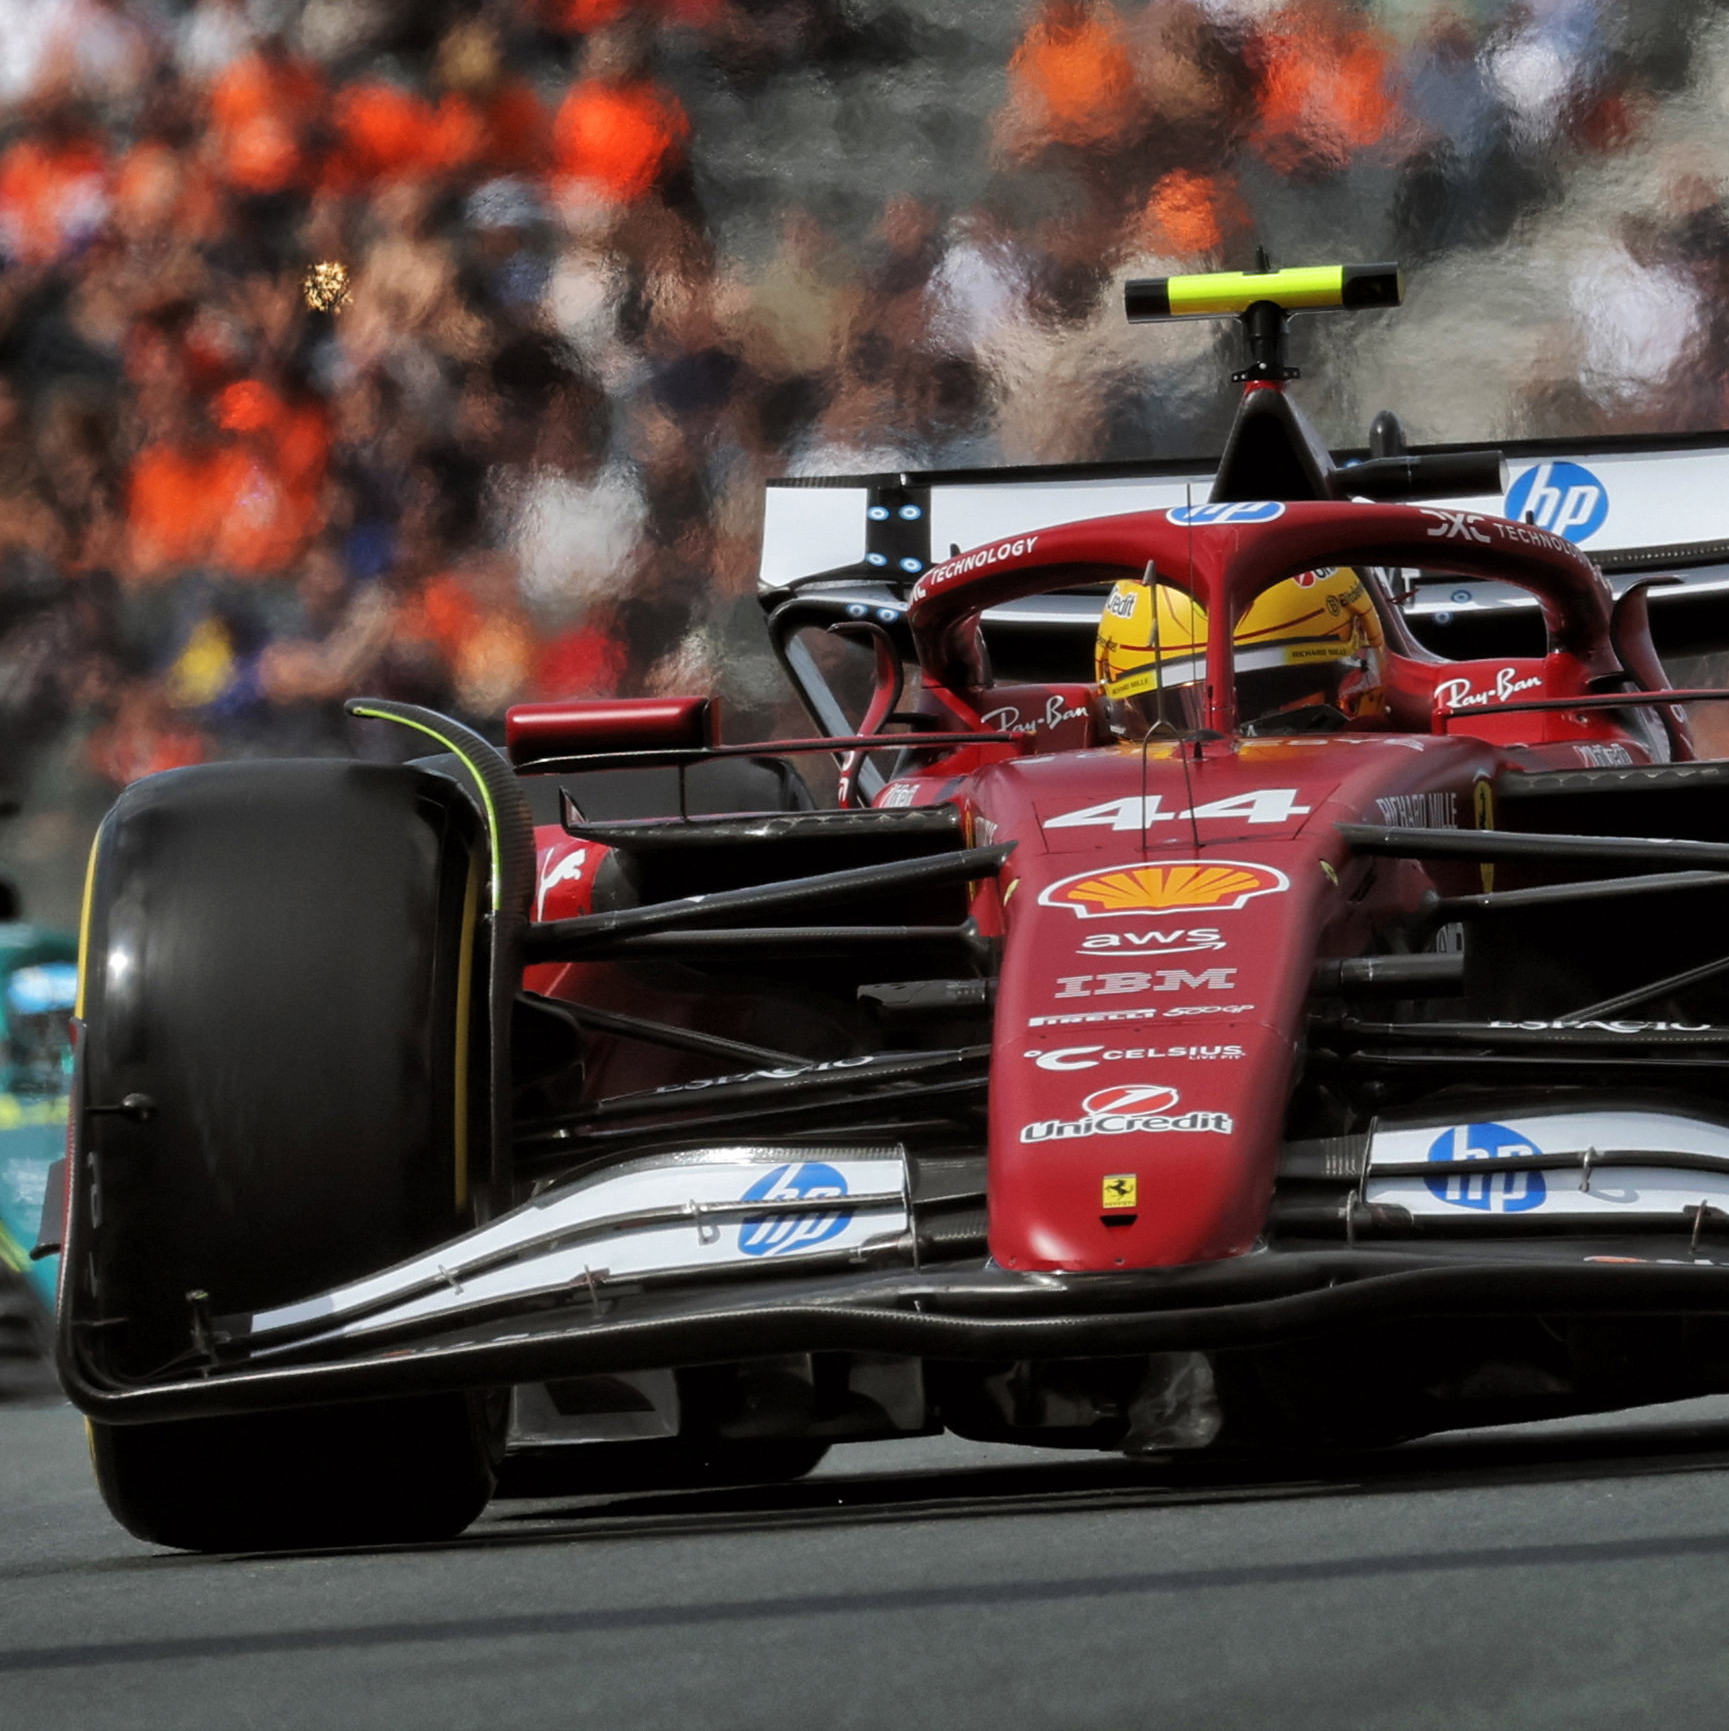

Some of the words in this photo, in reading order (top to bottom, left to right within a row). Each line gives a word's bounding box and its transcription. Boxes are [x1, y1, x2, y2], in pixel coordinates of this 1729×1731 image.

[1518, 462, 1600, 538] hp
[1420, 509, 1491, 543] DXC
[1492, 522, 1590, 566] TECHNOLO
[930, 536, 1038, 585] TECHNOLOGY
[1434, 668, 1542, 708] Ray-Ban
[1043, 789, 1311, 830] 44
[1082, 927, 1222, 950] aws
[1054, 968, 1238, 999] IBM
[1027, 1008, 1157, 1027] PIRELLI
[1102, 1045, 1243, 1061] CELSIUS
[1024, 1112, 1230, 1141] UniCredit
[1445, 1123, 1535, 1214] hp
[744, 1162, 842, 1256] hp
